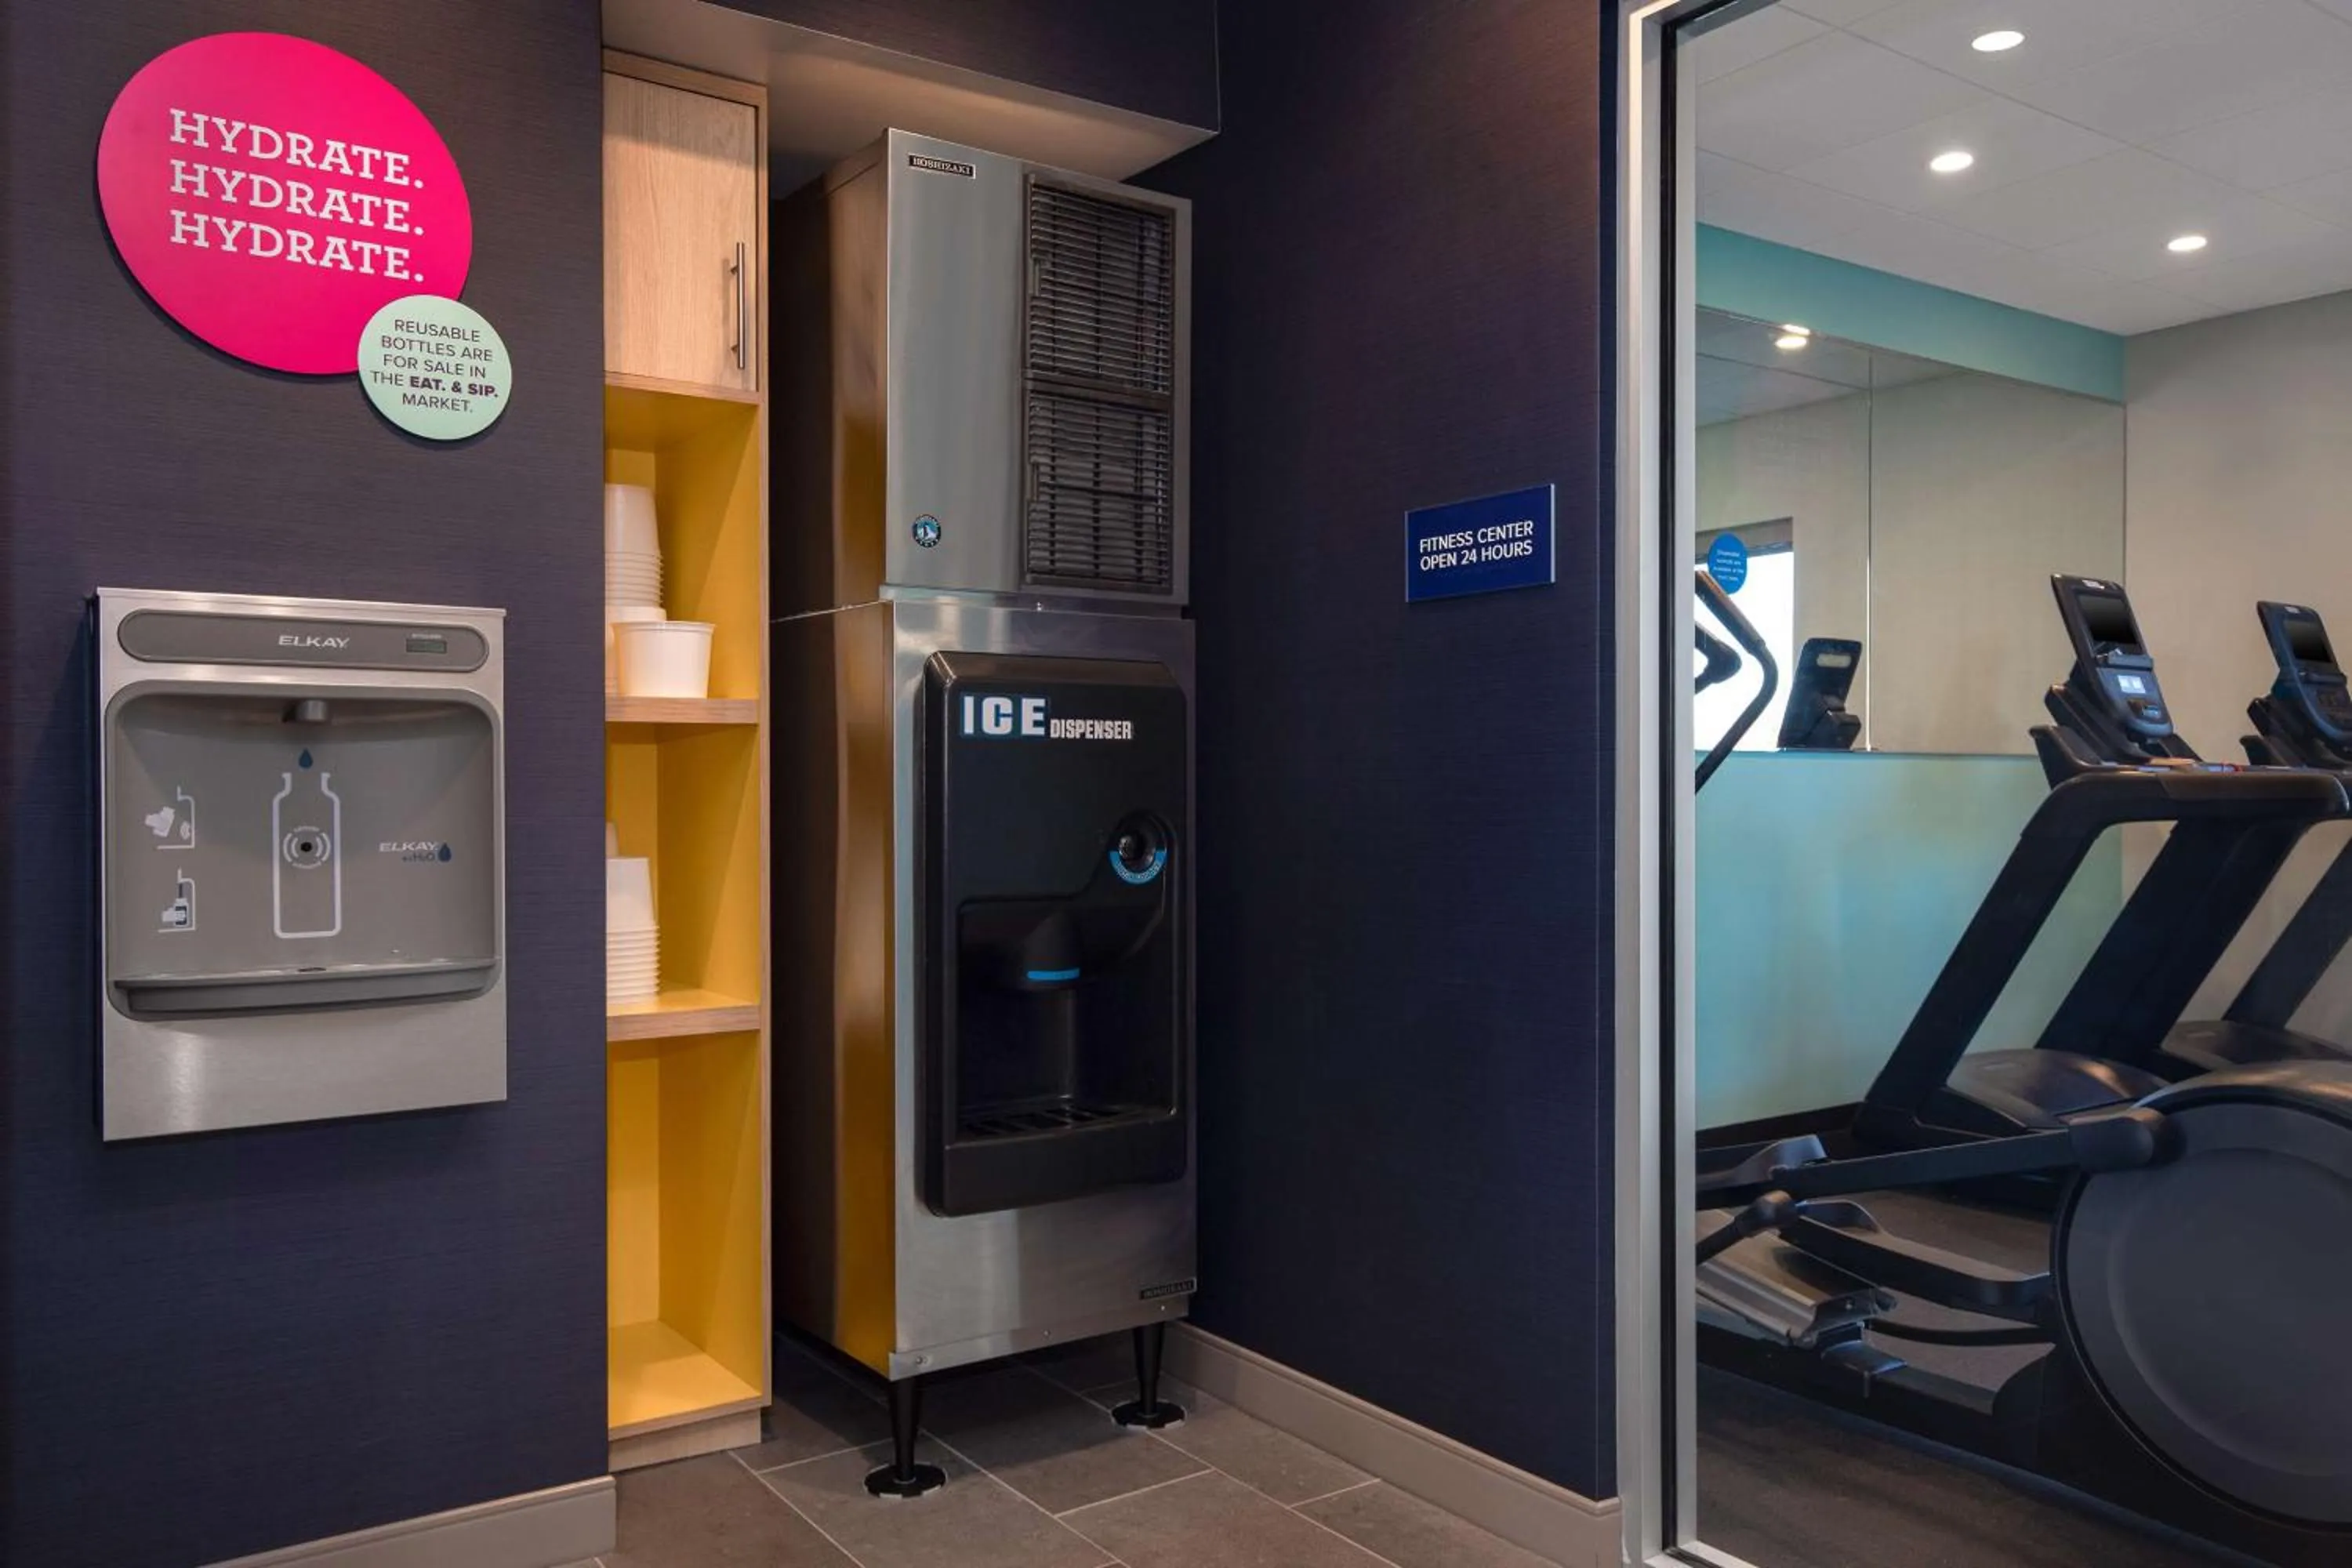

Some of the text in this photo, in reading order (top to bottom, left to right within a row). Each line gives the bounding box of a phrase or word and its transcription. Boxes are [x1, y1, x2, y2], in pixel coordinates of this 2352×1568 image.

[169, 108, 424, 189] HYDRATE.
[169, 159, 424, 236] HYDRATE.
[169, 209, 424, 281] HYDRATE.
[394, 319, 481, 343] REUSABLE
[382, 336, 493, 361] BOTTLES ARE
[383, 354, 486, 379] FOR SALE IN
[370, 370, 499, 397] THE EAT. & SIP.
[402, 393, 473, 413] MARKET.
[1419, 520, 1534, 554] FITNESS CENTER
[1420, 539, 1533, 572] OPEN 24 HOURS
[278, 635, 350, 648] ELKAY
[964, 696, 1132, 739] ICE DISPENSER
